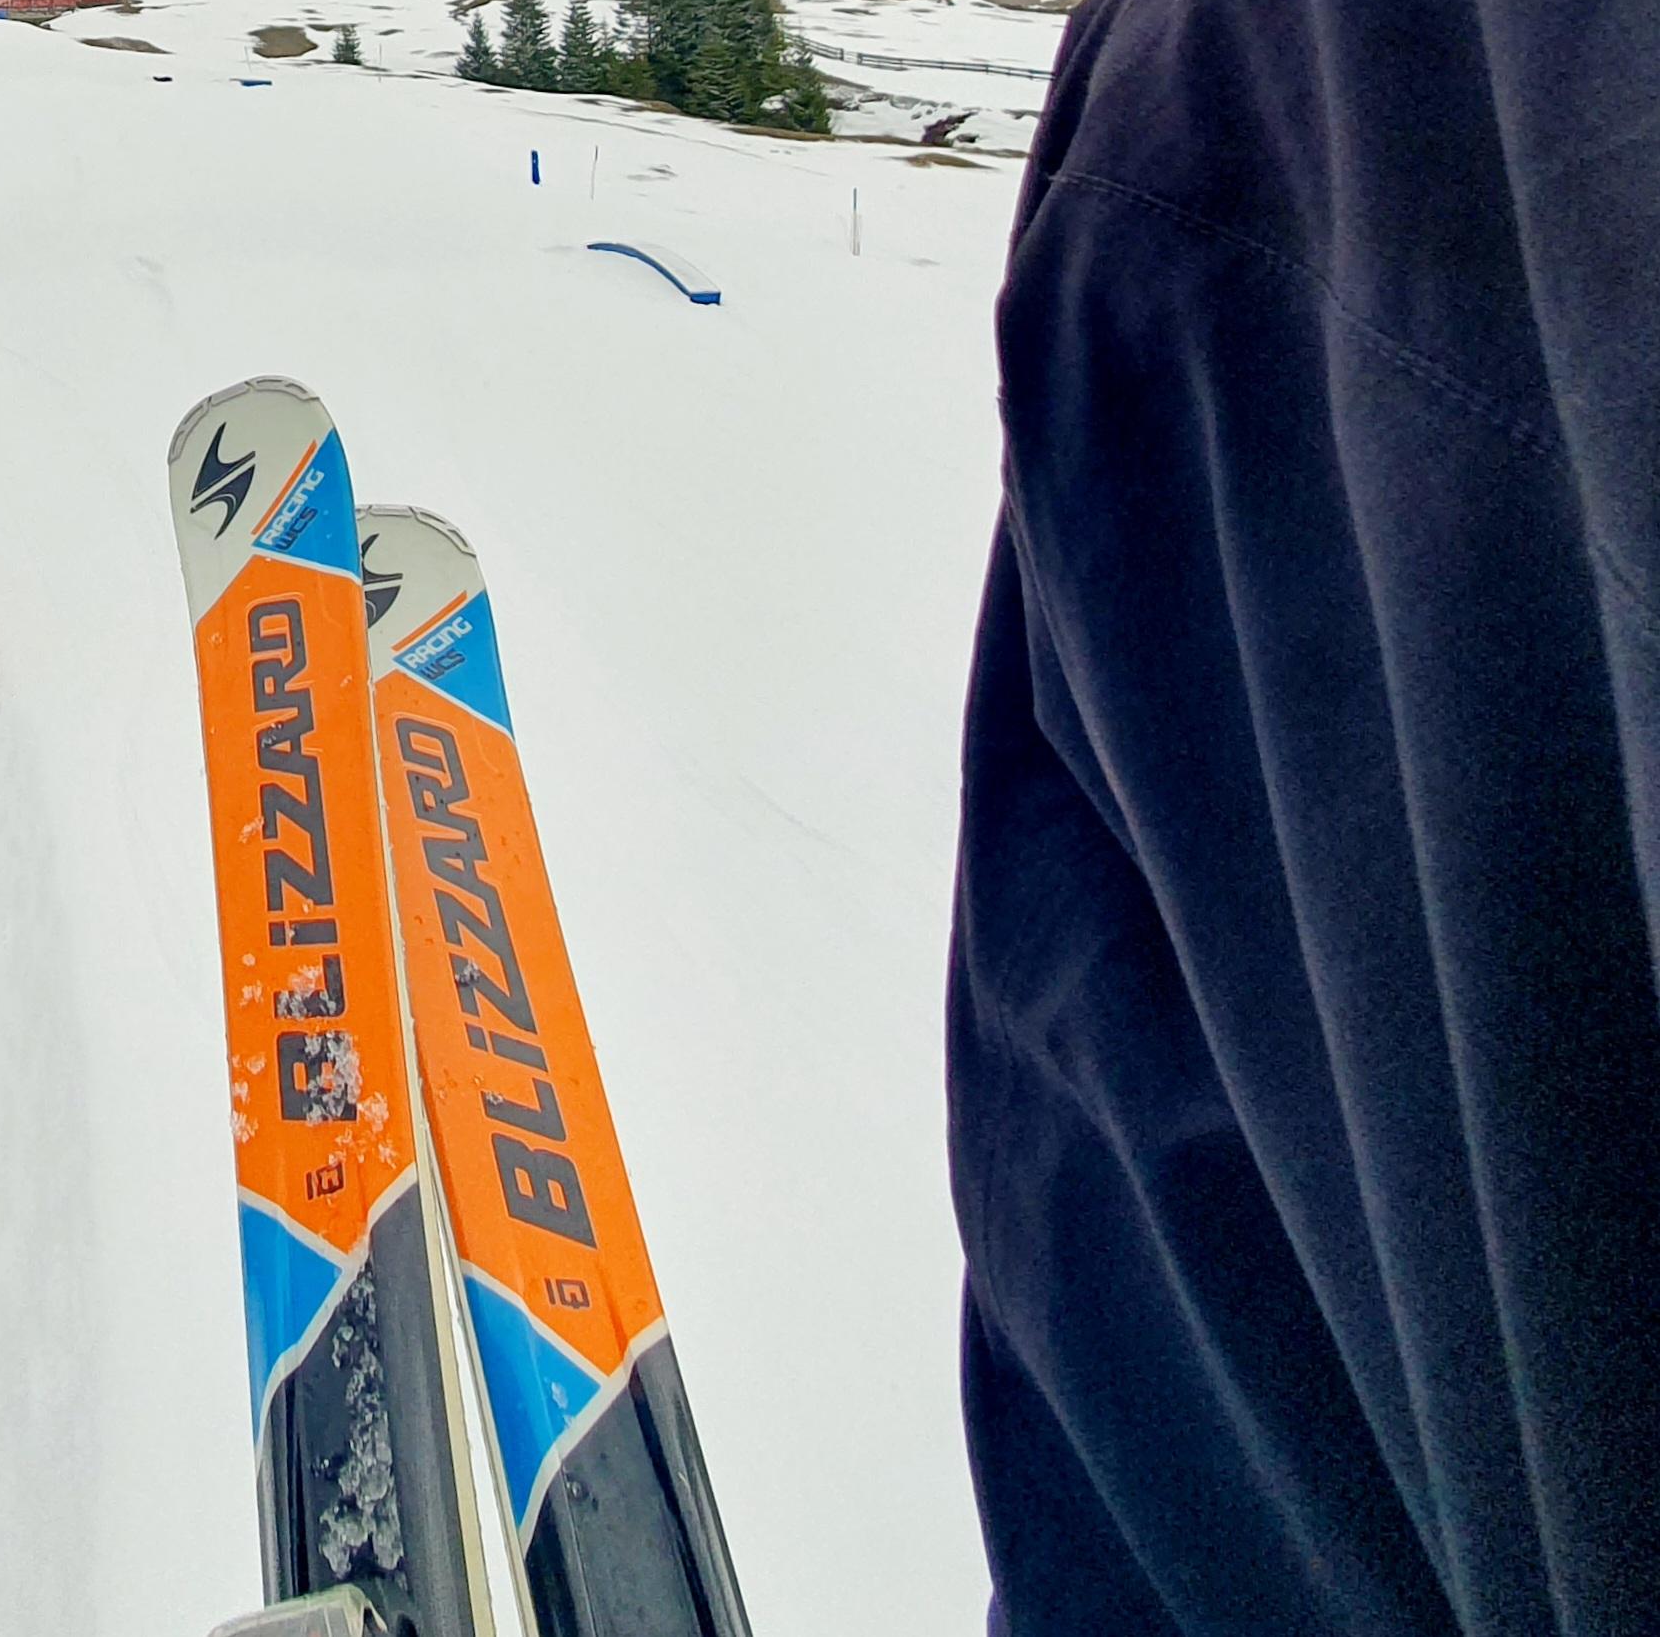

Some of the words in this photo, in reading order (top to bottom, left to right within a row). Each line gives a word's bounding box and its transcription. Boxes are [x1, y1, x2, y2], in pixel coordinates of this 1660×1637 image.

[260, 467, 325, 545] RACING
[402, 616, 473, 669] RACING
[543, 1276, 590, 1310] IQ
